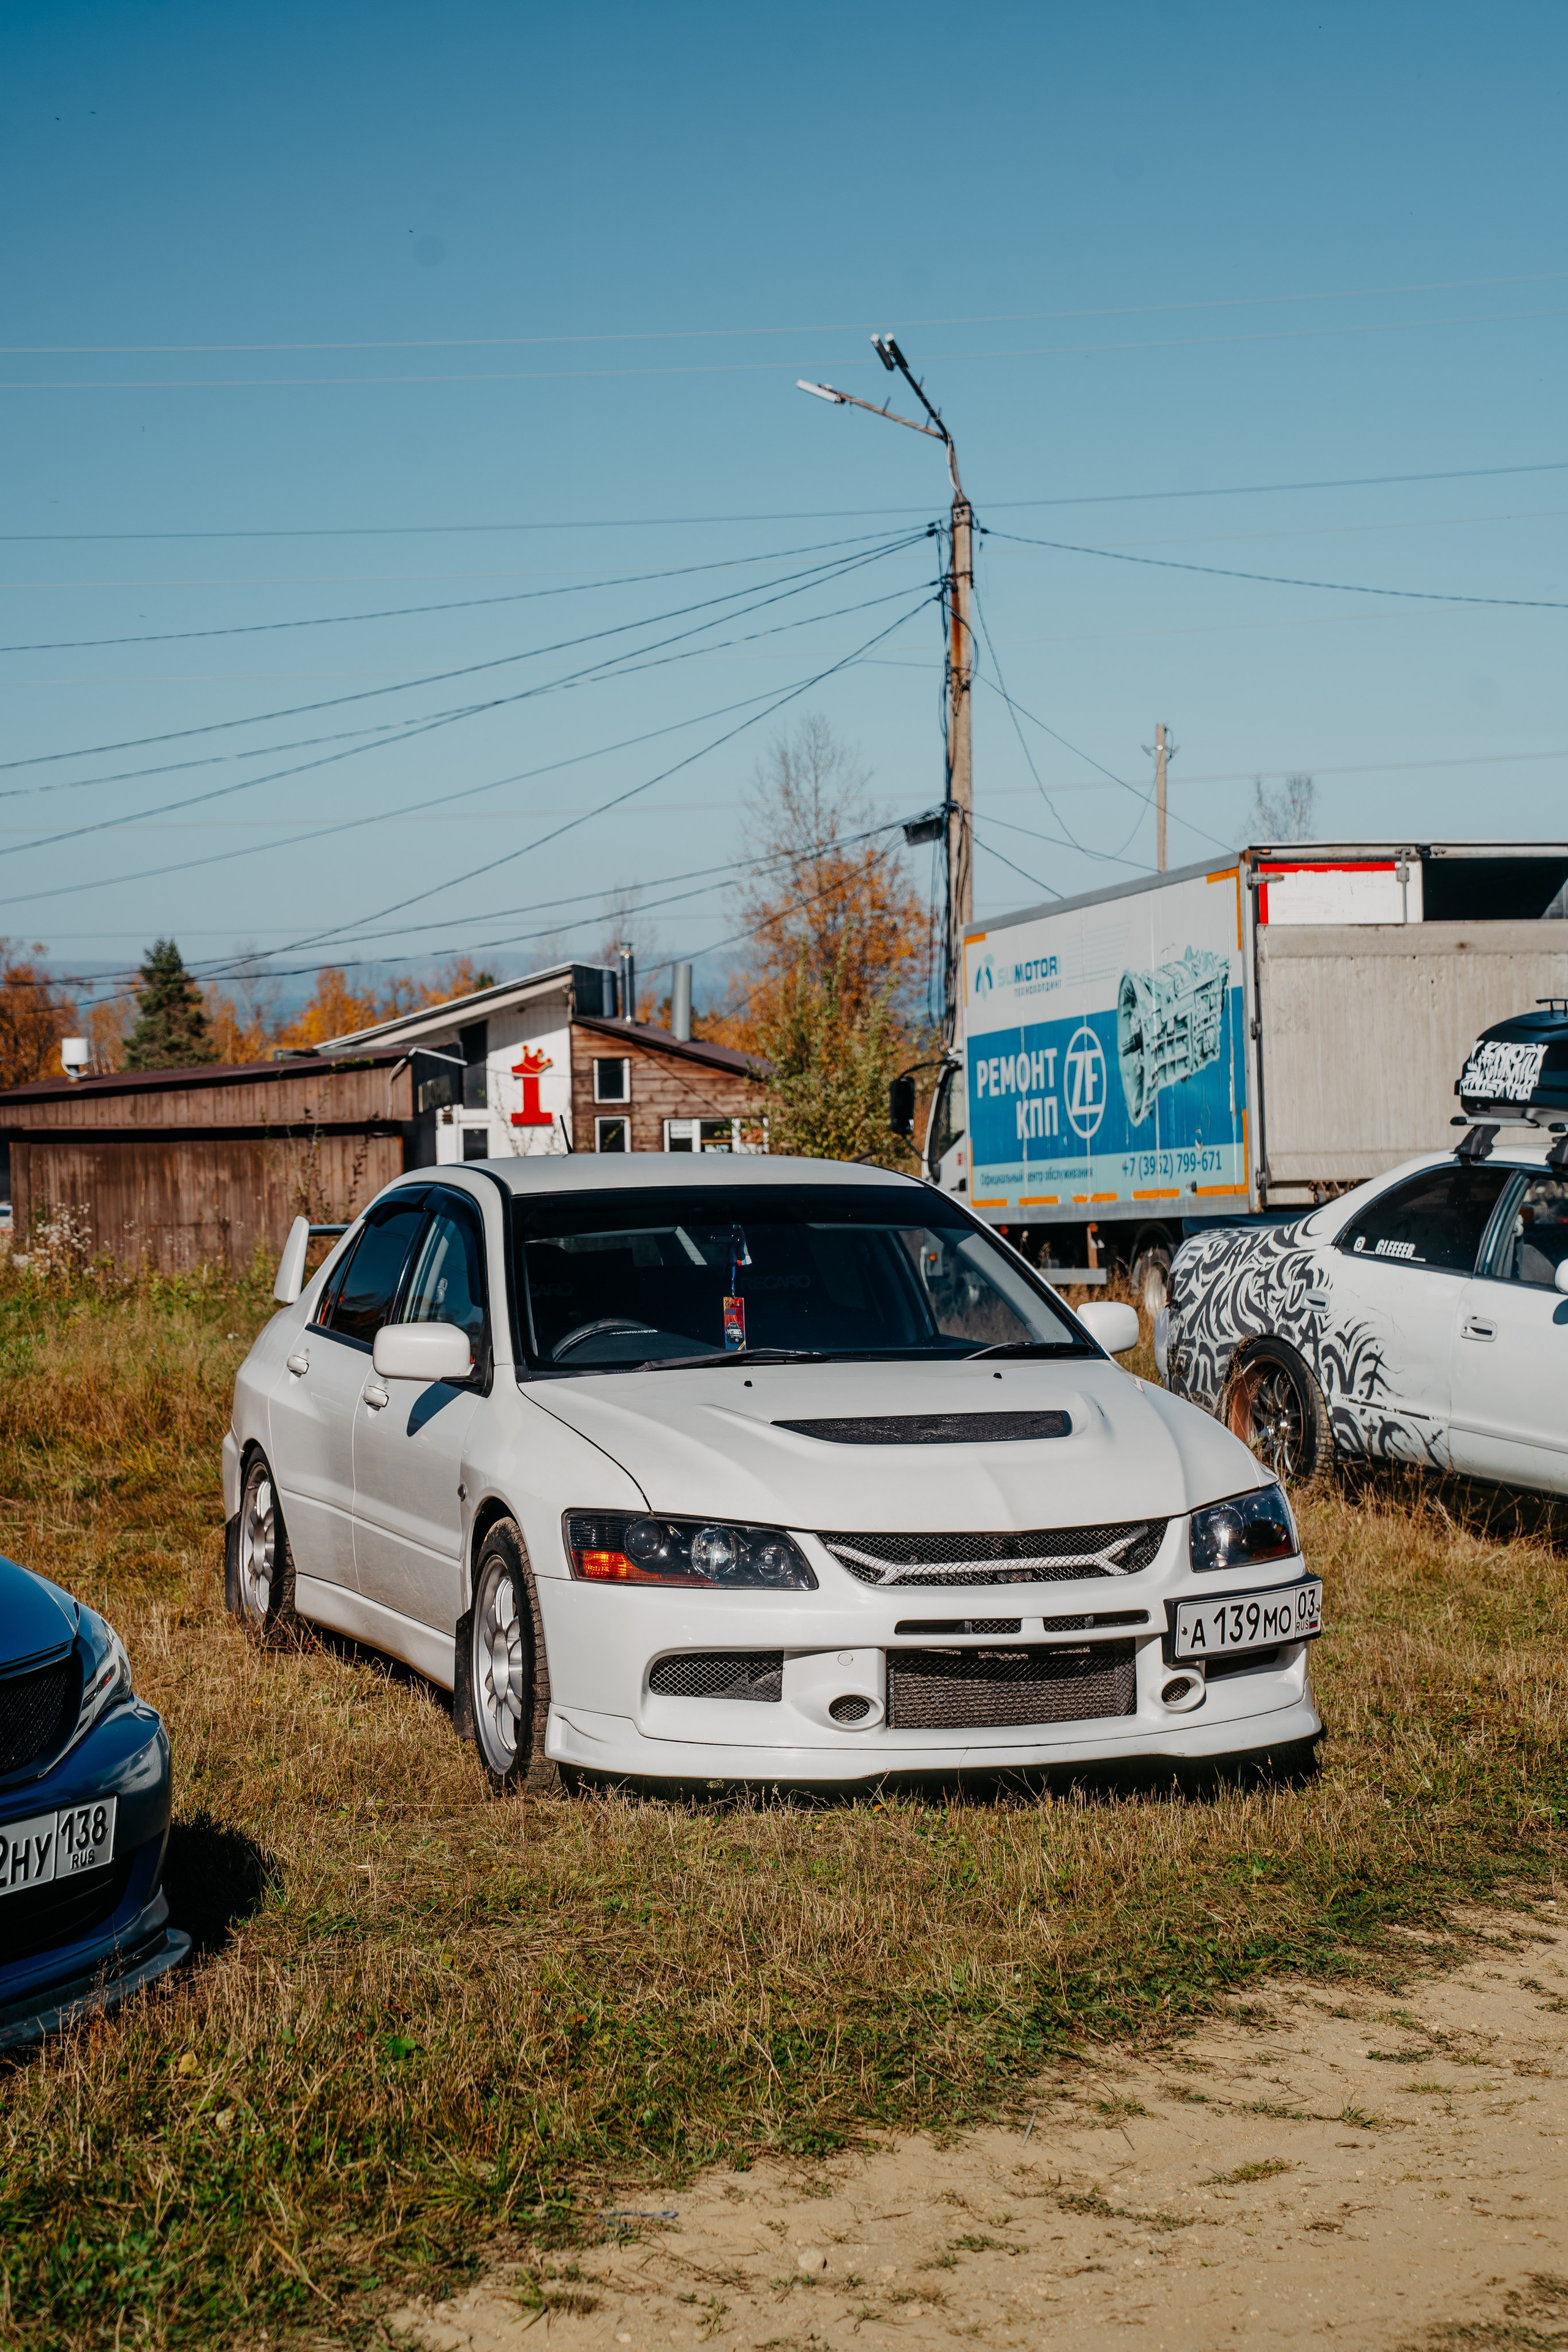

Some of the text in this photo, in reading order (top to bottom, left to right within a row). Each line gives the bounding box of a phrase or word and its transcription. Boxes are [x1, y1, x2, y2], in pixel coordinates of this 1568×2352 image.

[976, 1047, 1058, 1098] РЕМОНТ
[1068, 1049, 1101, 1116] ZF
[1016, 1096, 1058, 1140] КПП
[1027, 1170, 1042, 1184] ентр
[1121, 1158, 1135, 1177] +7
[1176, 1150, 1222, 1174] 799-671
[529, 1283, 574, 1297] CARO
[740, 1274, 811, 1290] RECARO
[1298, 1589, 1315, 1619] 03
[1296, 1619, 1309, 1632] RUS
[59, 1805, 107, 1854] 138
[70, 1849, 95, 1869] RUS
